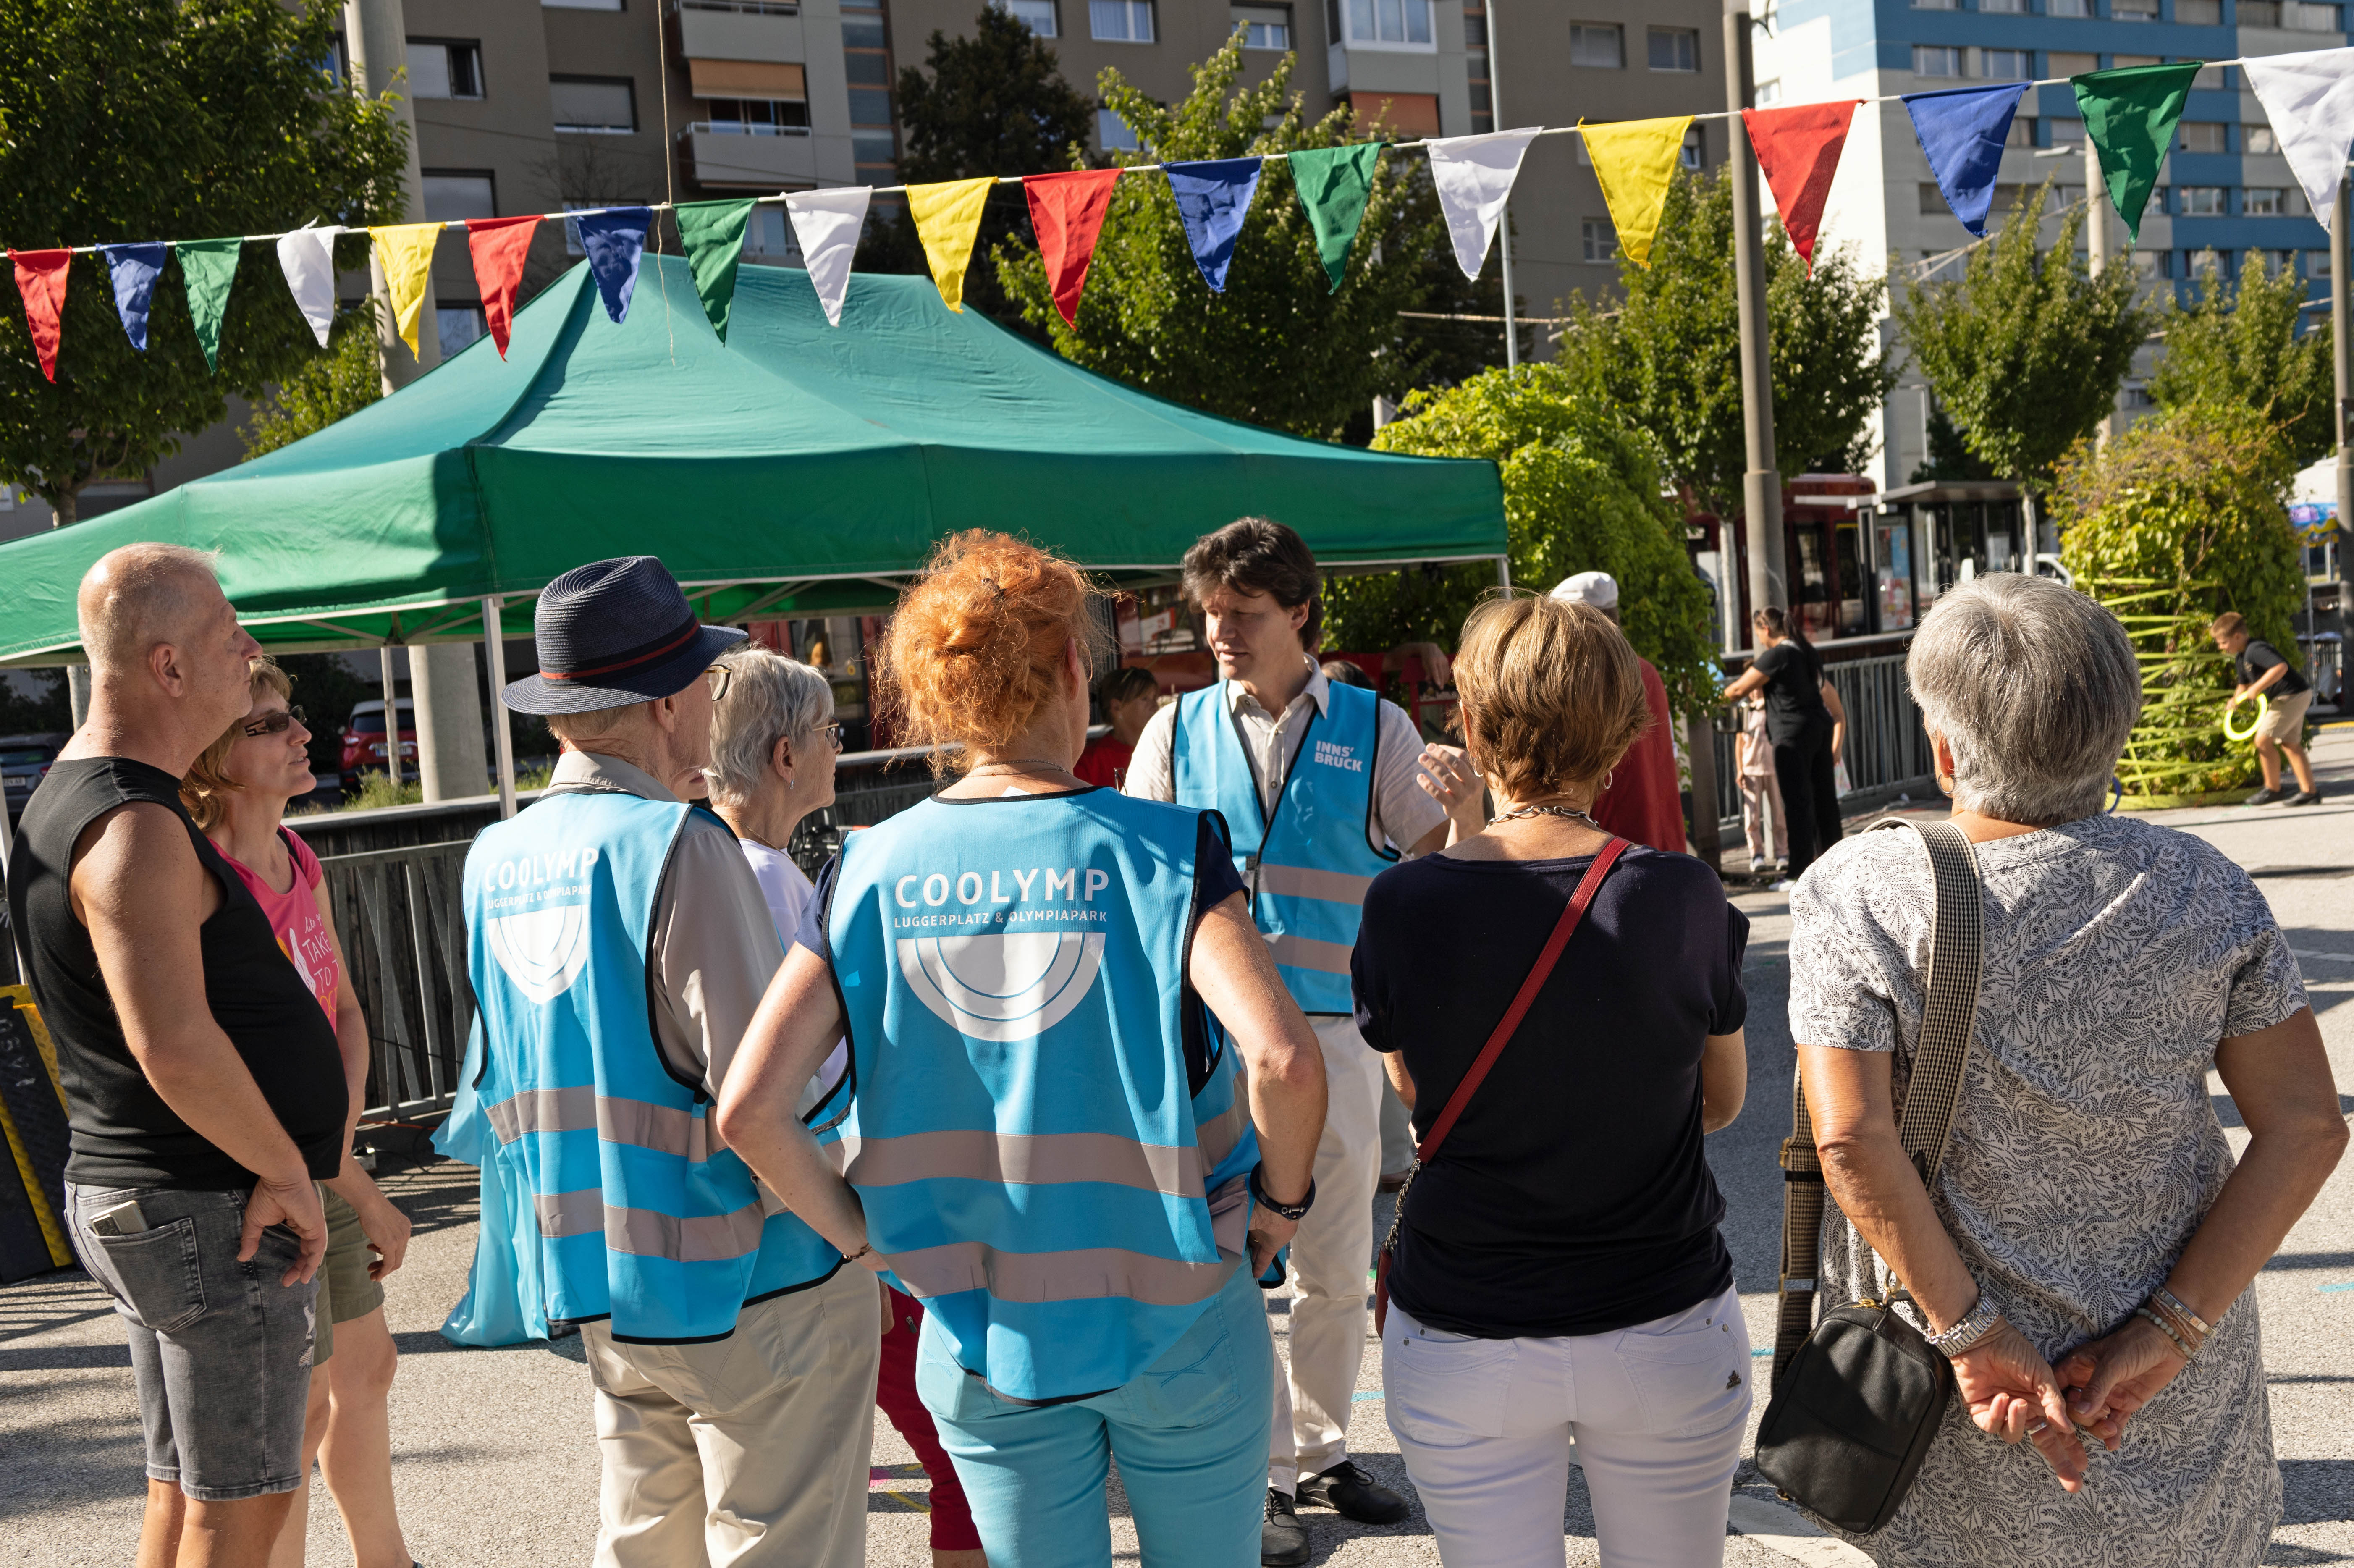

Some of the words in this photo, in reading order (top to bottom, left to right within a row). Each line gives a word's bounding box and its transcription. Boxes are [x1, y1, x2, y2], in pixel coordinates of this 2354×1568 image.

[1316, 740, 1354, 757] INNS'
[1314, 752, 1363, 772] BRUCK
[485, 847, 599, 892] COOLYMP
[536, 891, 542, 901] &
[894, 868, 1109, 908] COOLYMP
[894, 912, 989, 928] LUGGERPLATZ
[995, 912, 1004, 923] &
[1009, 910, 1107, 923] OLYMPIAPARK
[302, 931, 332, 963] TAKE
[314, 967, 331, 993] TO
